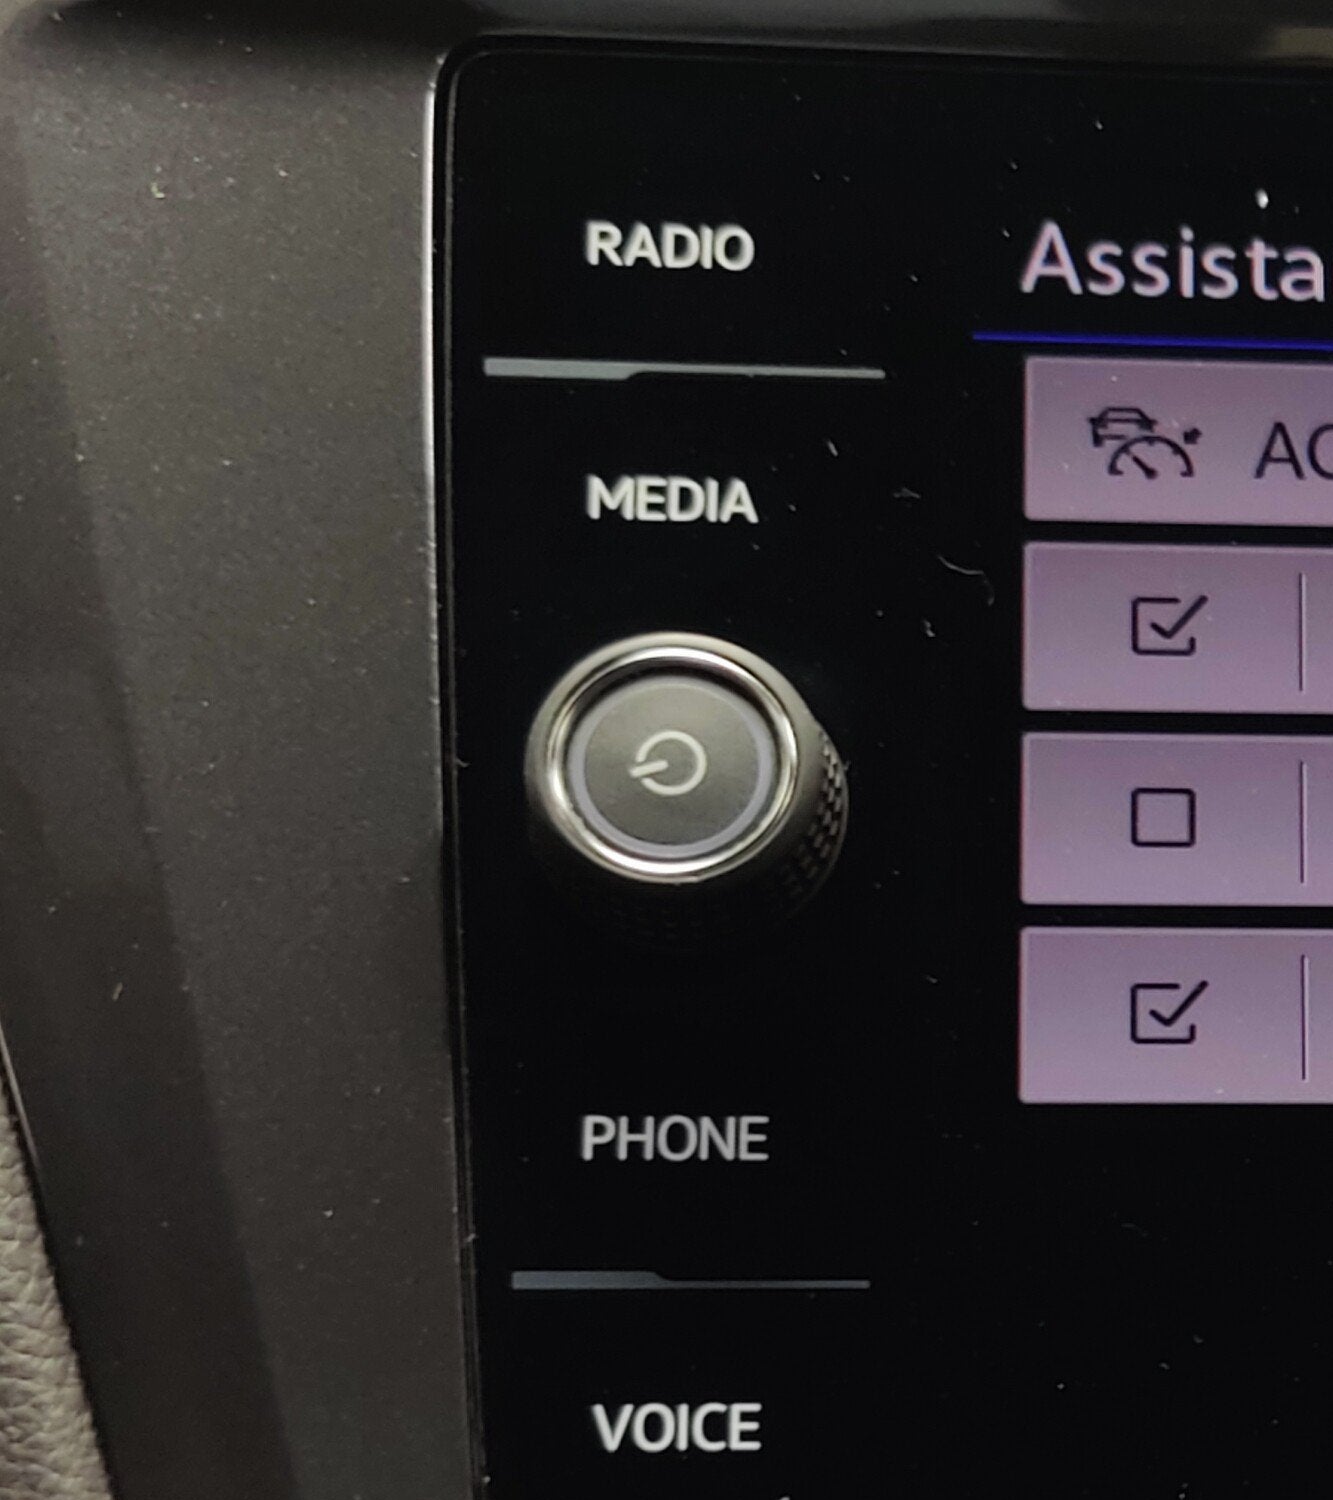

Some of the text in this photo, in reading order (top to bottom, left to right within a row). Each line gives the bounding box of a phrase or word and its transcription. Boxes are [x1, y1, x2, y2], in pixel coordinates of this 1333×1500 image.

[585, 219, 756, 273] RADIO
[586, 474, 760, 525] MEDIA
[580, 1113, 771, 1163] PHONE
[591, 1401, 763, 1454] VOICE
